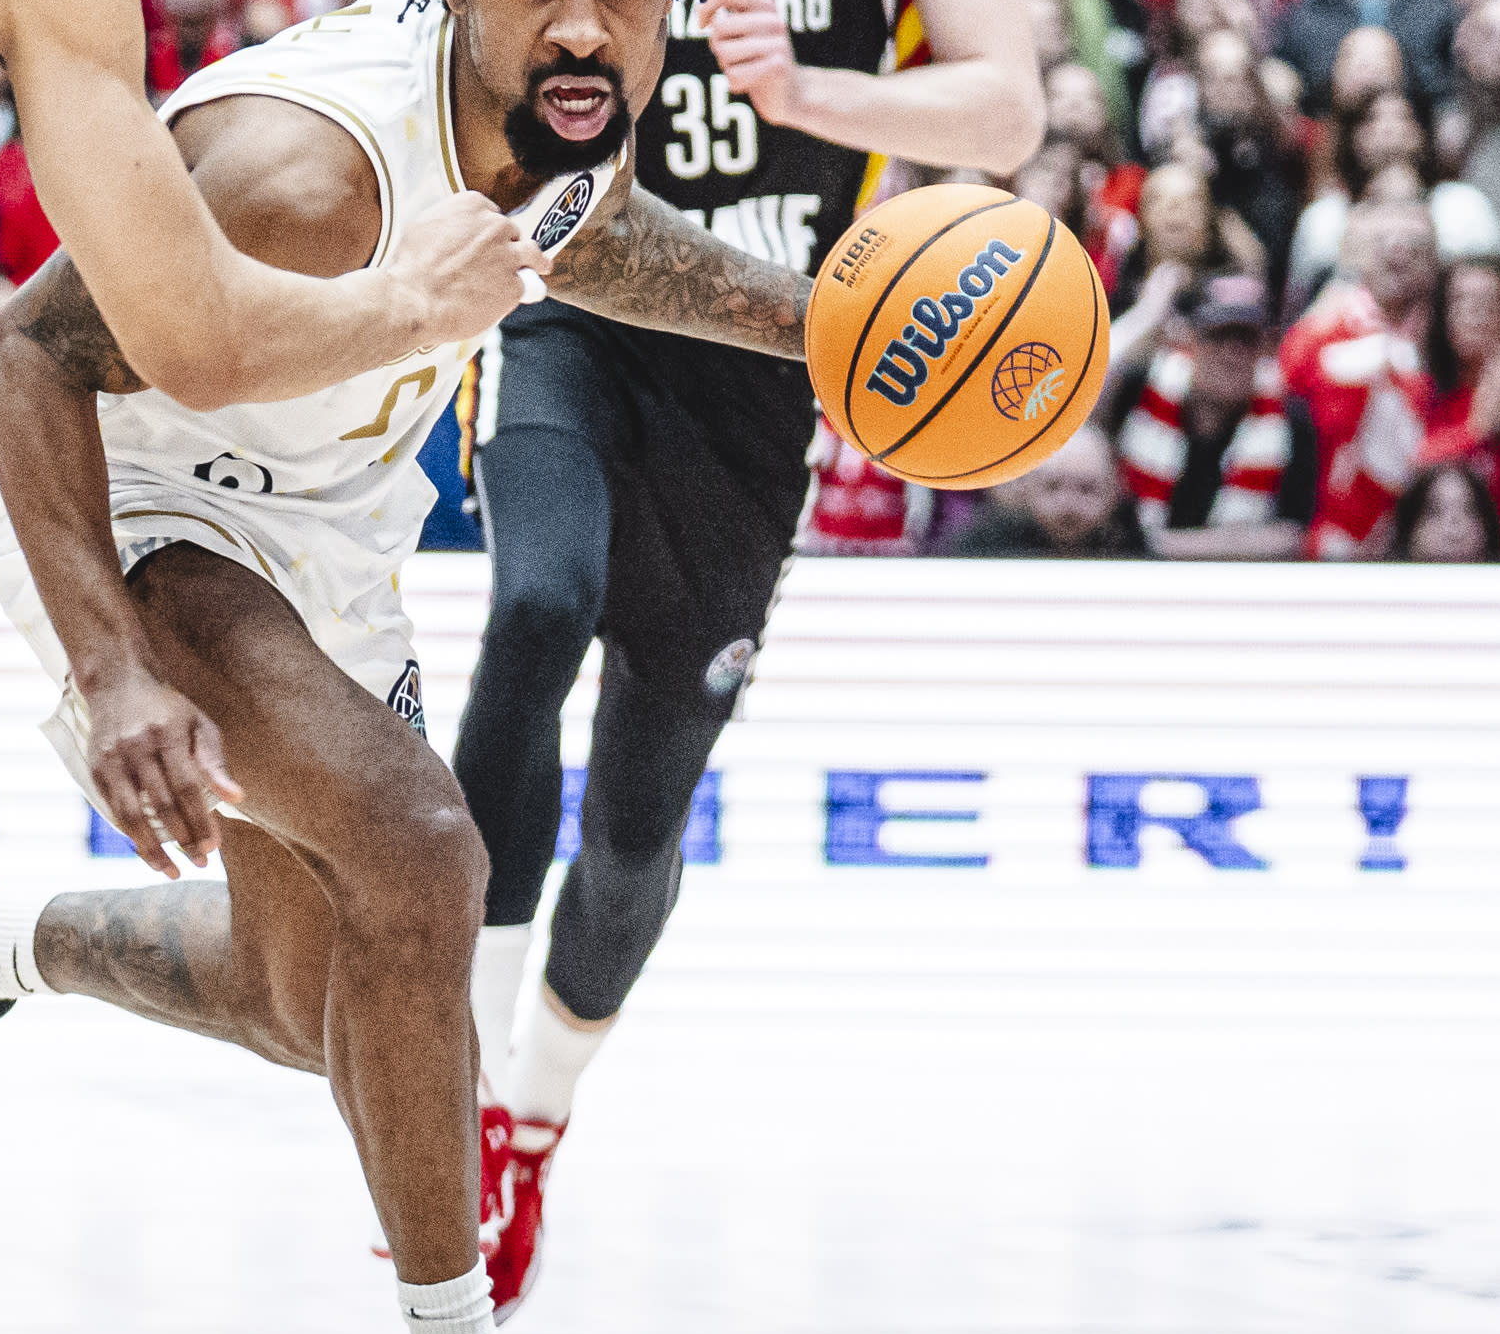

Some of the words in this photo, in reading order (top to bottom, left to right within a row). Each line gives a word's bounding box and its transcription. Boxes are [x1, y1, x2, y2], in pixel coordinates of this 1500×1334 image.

[661, 73, 757, 179] 35
[832, 227, 879, 283] FIBA
[845, 234, 888, 289] APPROVED
[865, 238, 1025, 407] Wilson
